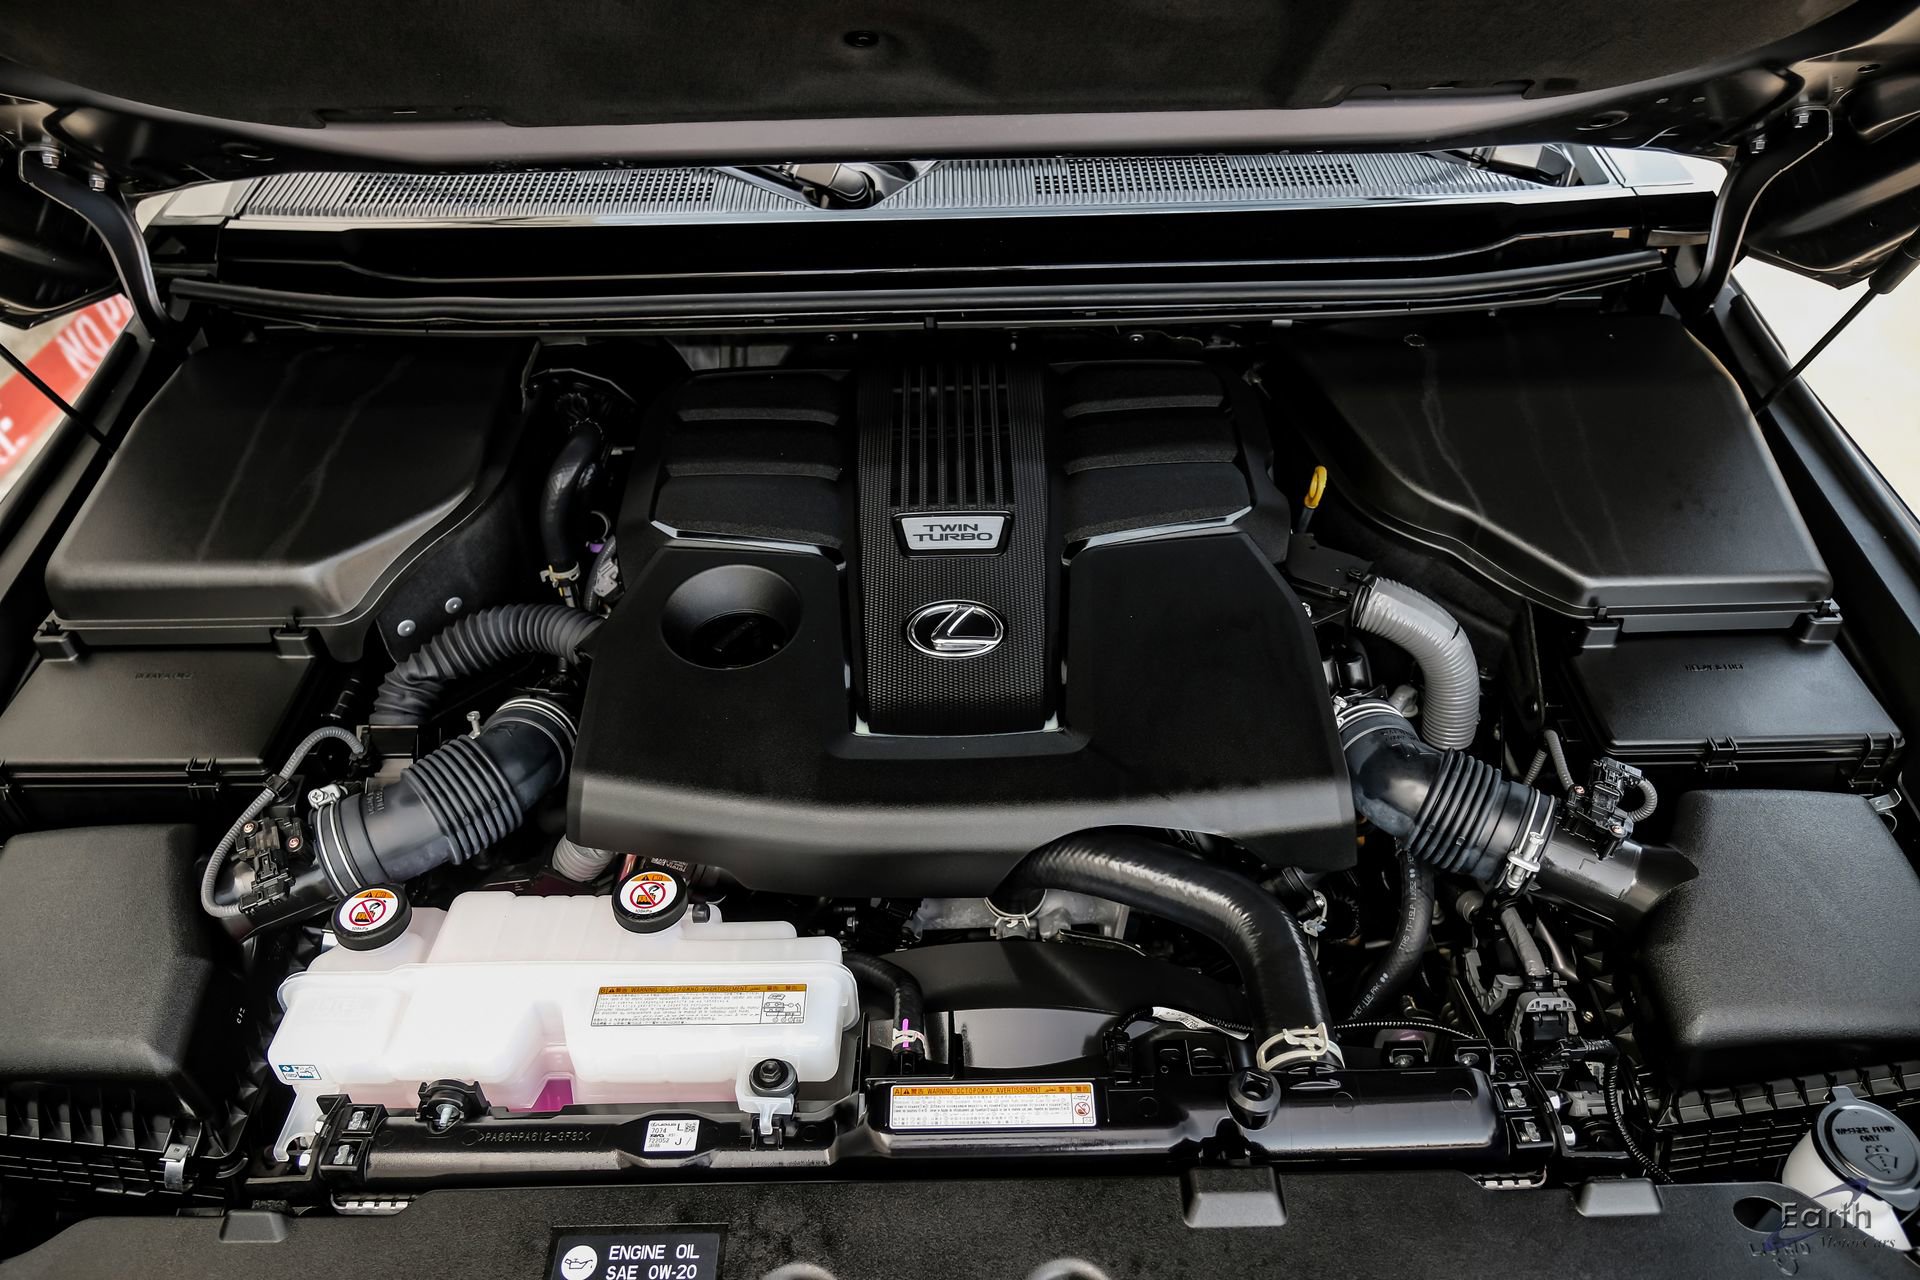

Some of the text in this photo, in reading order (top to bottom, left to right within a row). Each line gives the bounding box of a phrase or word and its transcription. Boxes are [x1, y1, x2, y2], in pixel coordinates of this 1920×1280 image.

[922, 523, 979, 532] TWIN
[912, 532, 993, 542] TURBO
[608, 1244, 700, 1260] ENGINE OIL
[605, 1265, 639, 1280] SAE
